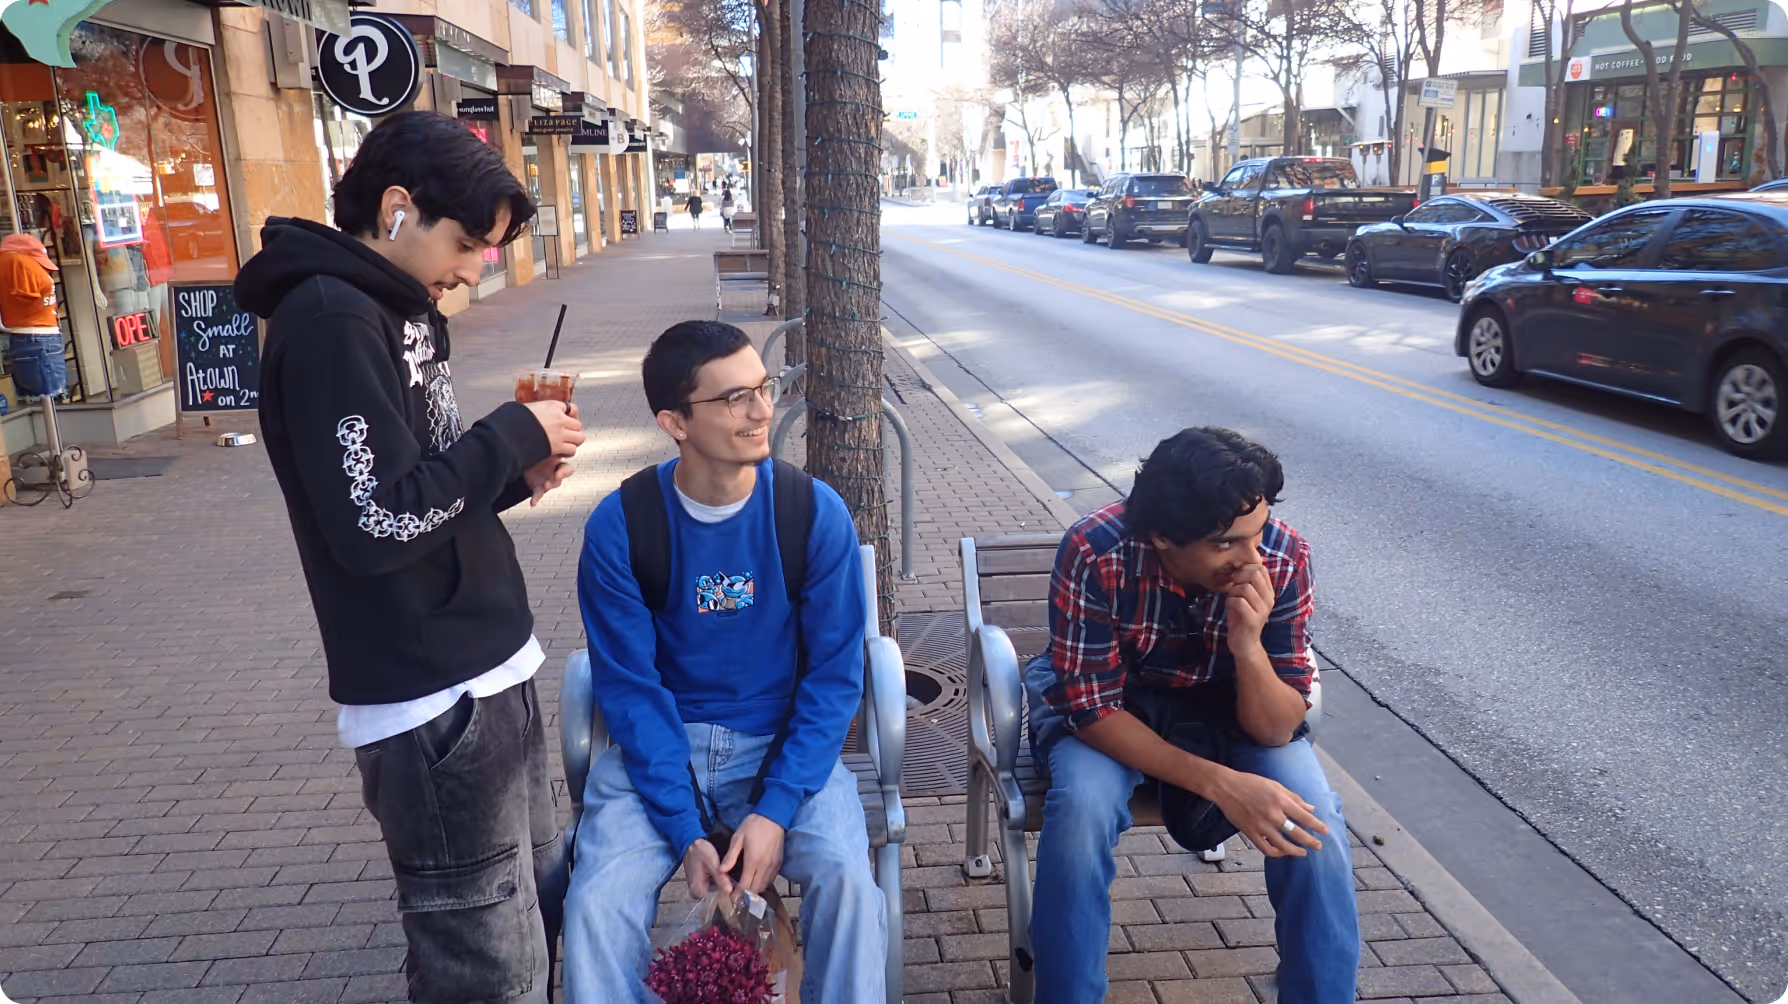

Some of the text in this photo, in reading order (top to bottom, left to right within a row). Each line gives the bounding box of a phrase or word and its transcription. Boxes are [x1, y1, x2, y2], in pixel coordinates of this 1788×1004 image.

[334, 25, 389, 105] P
[1595, 63, 1609, 72] HOT
[1611, 61, 1640, 69] COFFEE
[458, 105, 495, 114] sunglass hut
[179, 290, 217, 317] SHOP
[115, 312, 158, 346] OPEN
[193, 313, 254, 351] Small
[219, 344, 236, 358] AT
[218, 389, 259, 406] on 2n
